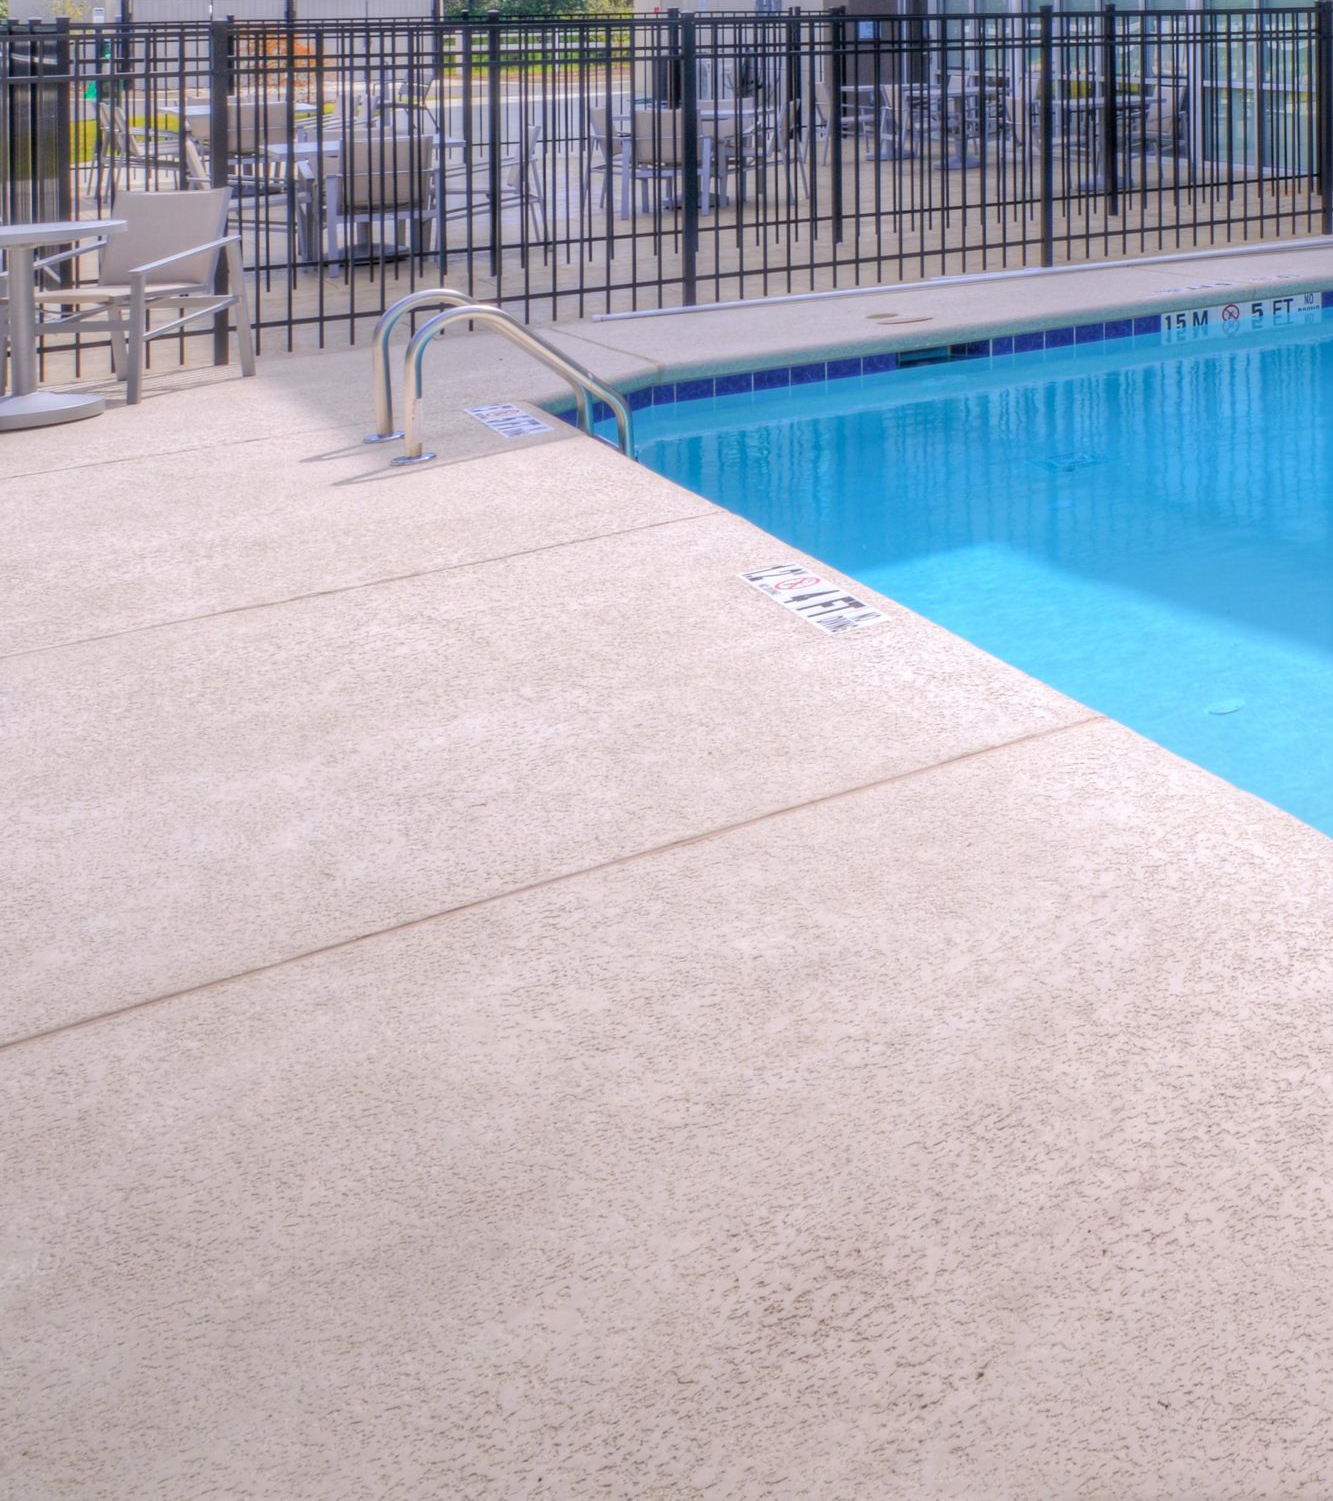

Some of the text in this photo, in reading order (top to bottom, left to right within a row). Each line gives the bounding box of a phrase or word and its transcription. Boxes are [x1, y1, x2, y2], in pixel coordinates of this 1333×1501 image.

[1272, 298, 1293, 316] FT
[784, 589, 840, 604] 4
[795, 596, 867, 618] FT
